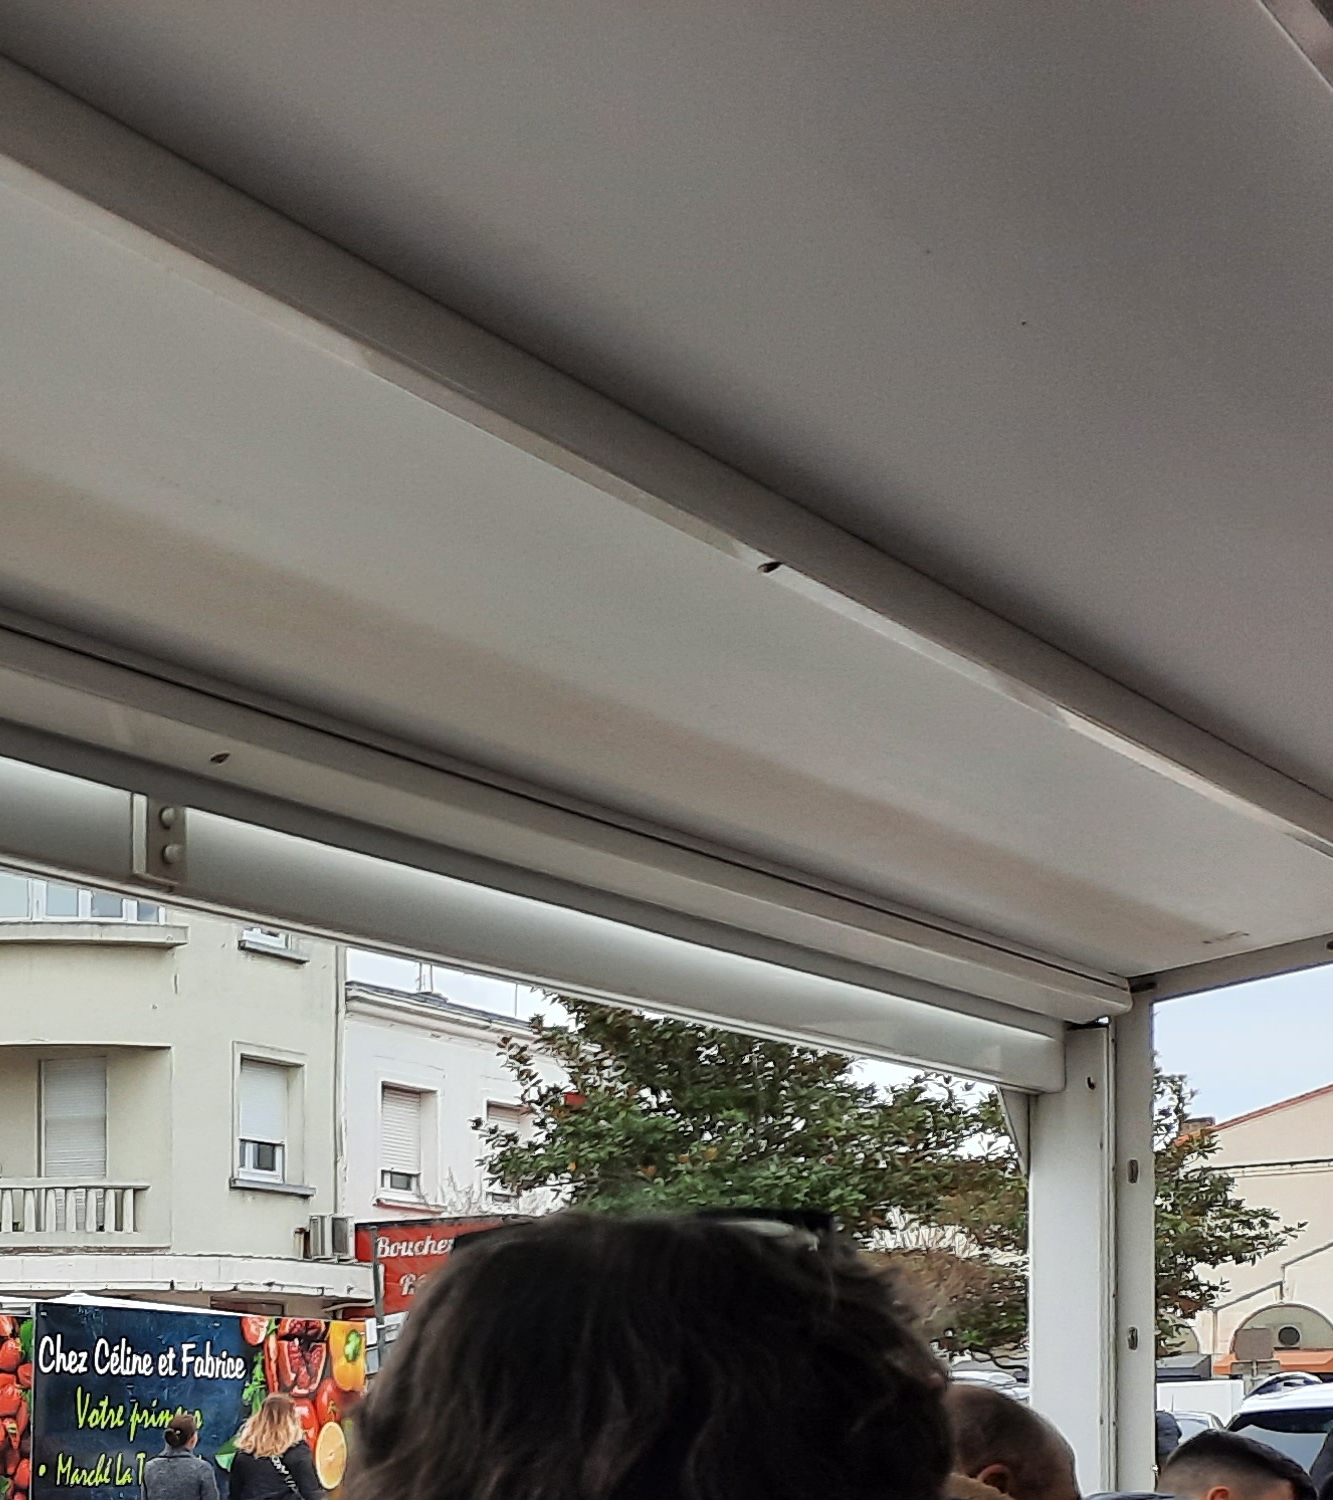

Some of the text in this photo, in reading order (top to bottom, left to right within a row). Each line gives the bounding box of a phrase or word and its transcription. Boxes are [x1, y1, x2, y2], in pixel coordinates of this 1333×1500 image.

[38, 1333, 247, 1380] Chez Céline et Fabrice
[76, 1386, 125, 1429] Votre
[56, 1452, 112, 1487] Marché
